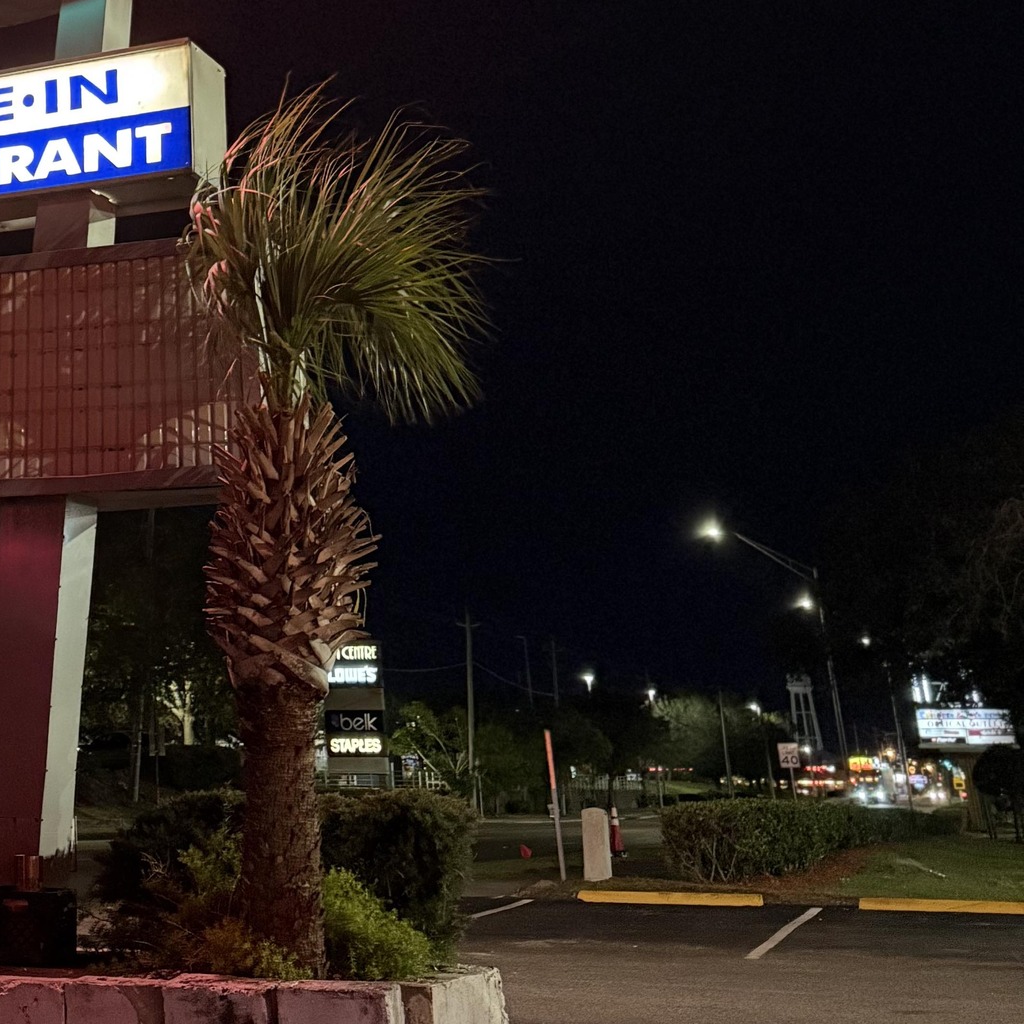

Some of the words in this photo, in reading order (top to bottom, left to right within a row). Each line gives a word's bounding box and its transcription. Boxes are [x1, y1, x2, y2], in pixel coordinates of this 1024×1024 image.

[342, 645, 377, 660] CENTRE
[340, 713, 378, 731] belk
[330, 738, 382, 753] STAPLES
[781, 755, 798, 765] 40
